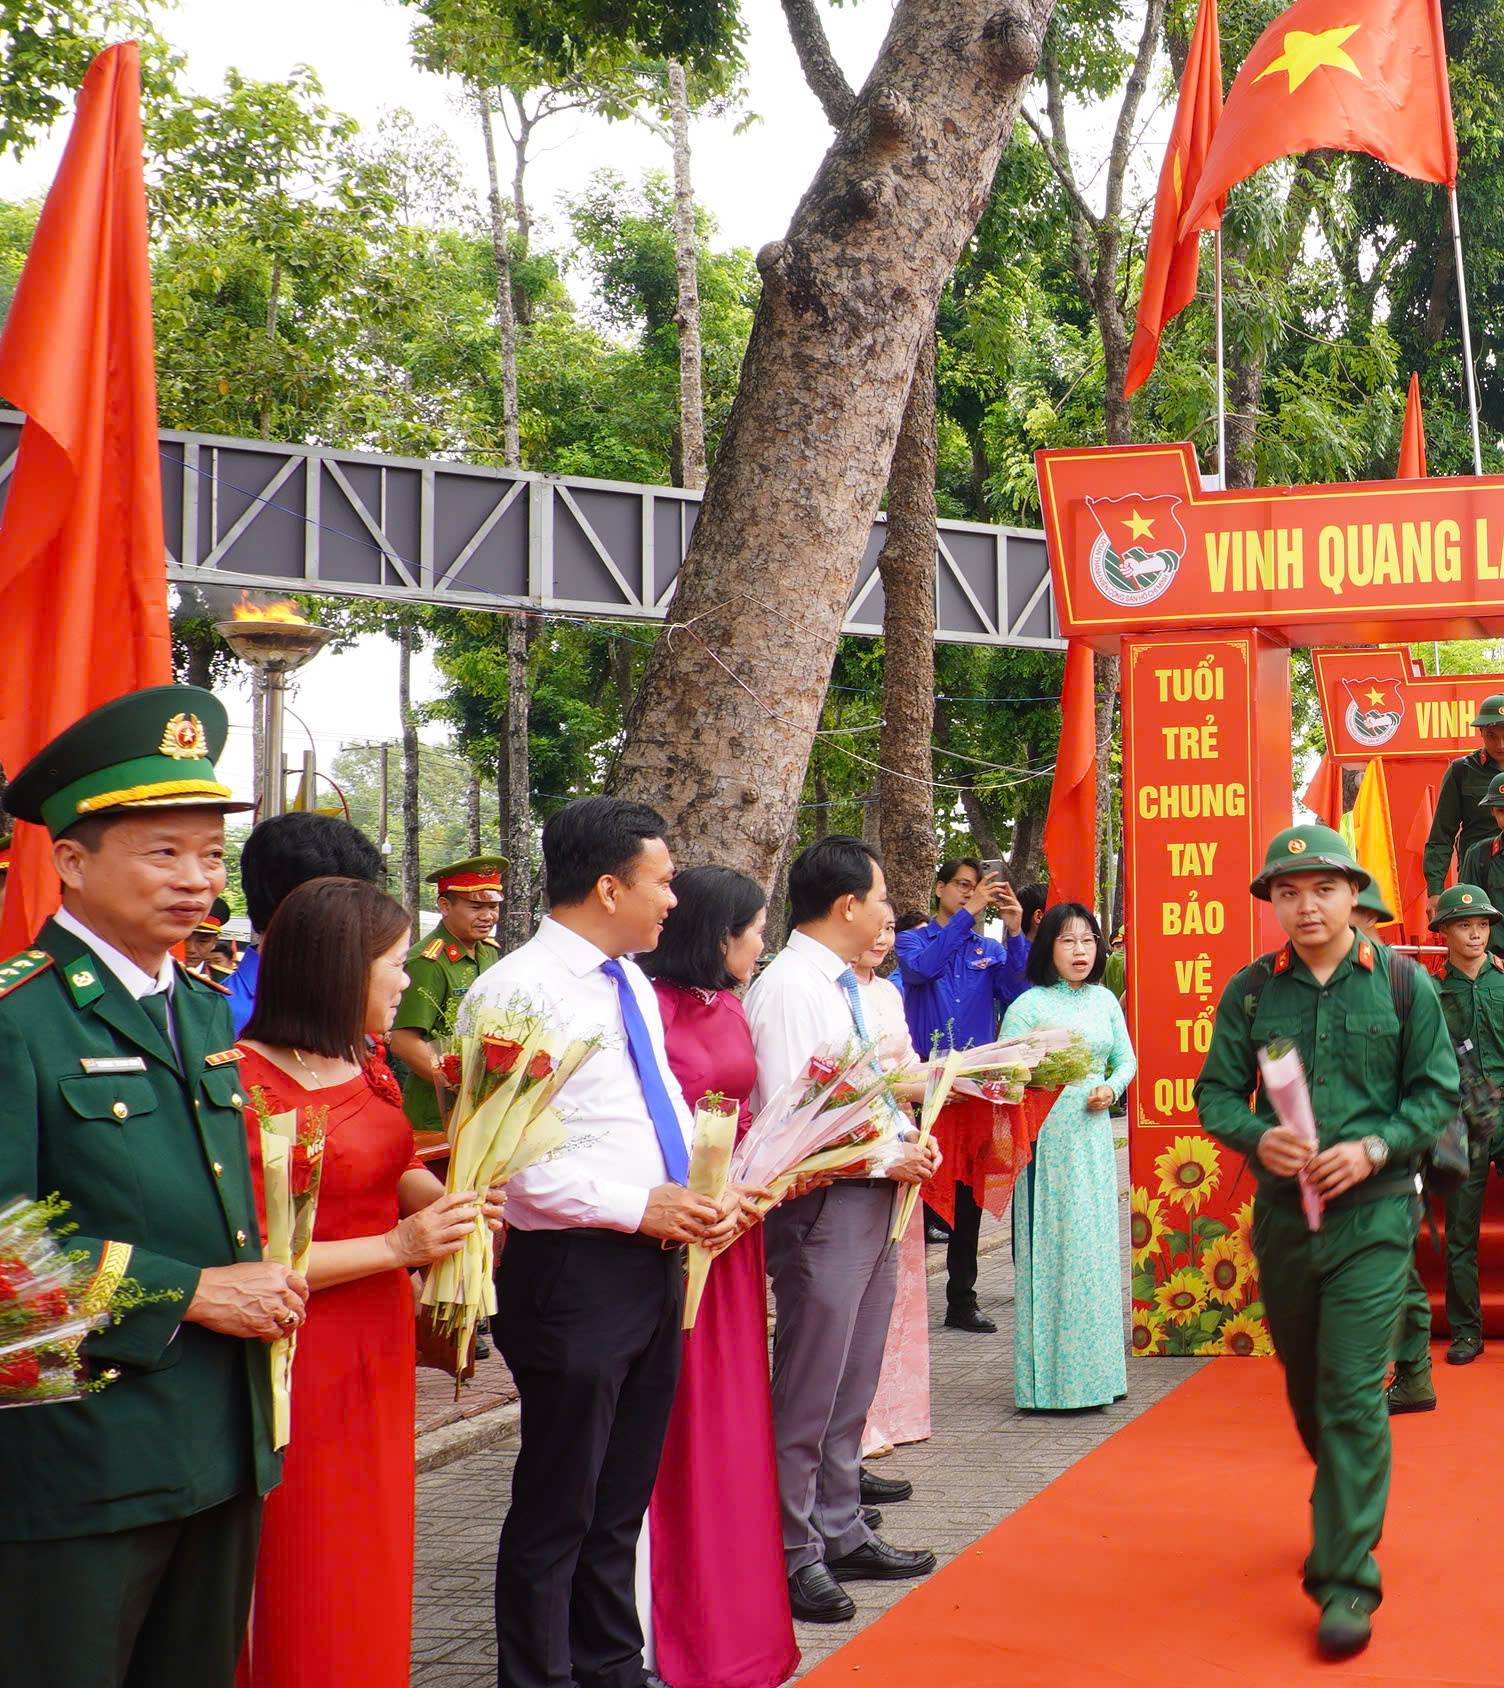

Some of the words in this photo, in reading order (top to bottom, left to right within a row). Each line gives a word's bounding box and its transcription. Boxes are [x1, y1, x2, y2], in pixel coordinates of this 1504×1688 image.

[1205, 527, 1304, 593] VINH
[1317, 519, 1462, 595] QUANG
[1155, 653, 1224, 702] TUỔI
[1161, 714, 1219, 760] TRẺ
[1415, 700, 1476, 740] VINH
[1138, 782, 1246, 820] CHUNG
[1167, 842, 1218, 877] TAY
[1162, 889, 1225, 936] BẢO
[1174, 952, 1213, 1001] VỆ
[1175, 1004, 1216, 1053] TỔ
